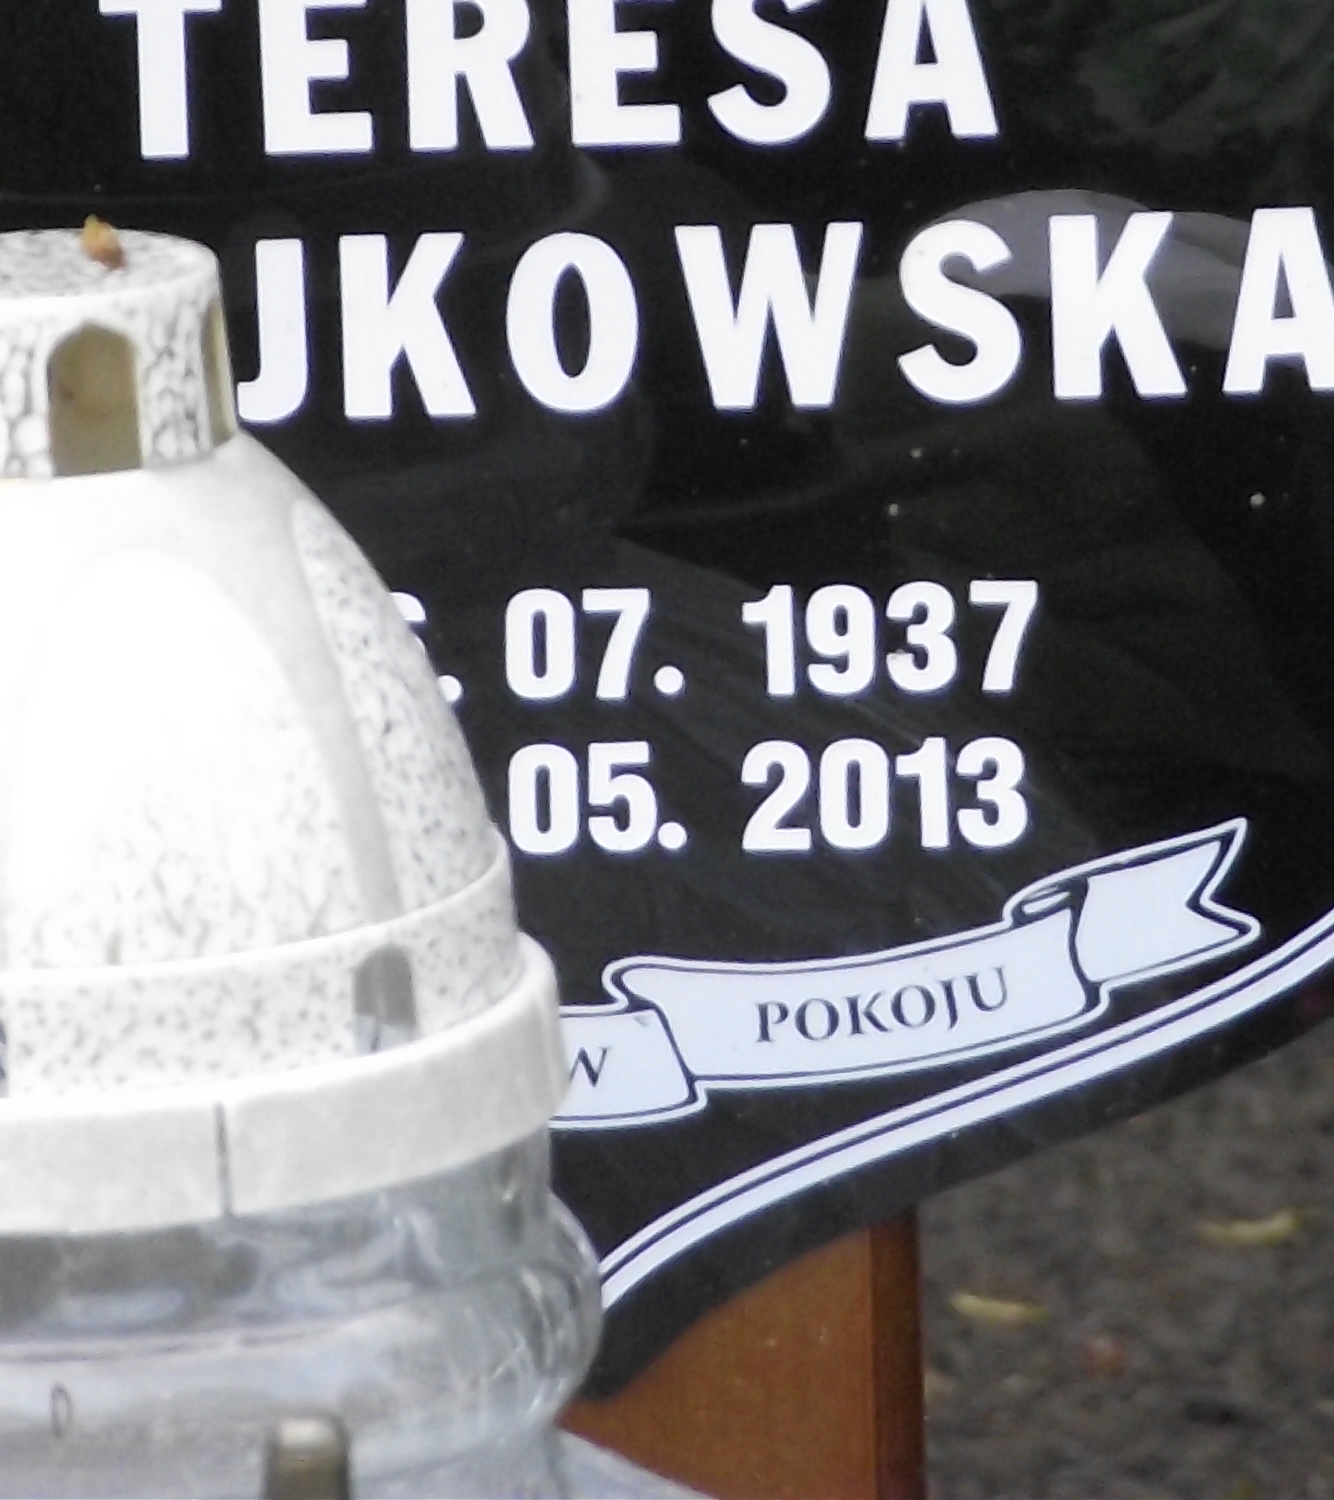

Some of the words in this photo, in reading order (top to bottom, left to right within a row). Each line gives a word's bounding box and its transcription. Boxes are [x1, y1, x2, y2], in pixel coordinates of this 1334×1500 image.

[504, 587, 686, 701] 07.
[741, 579, 1039, 698] 1937
[507, 739, 689, 857] 05.
[740, 736, 1029, 853] 2013
[755, 965, 1009, 1043] POKOJU
